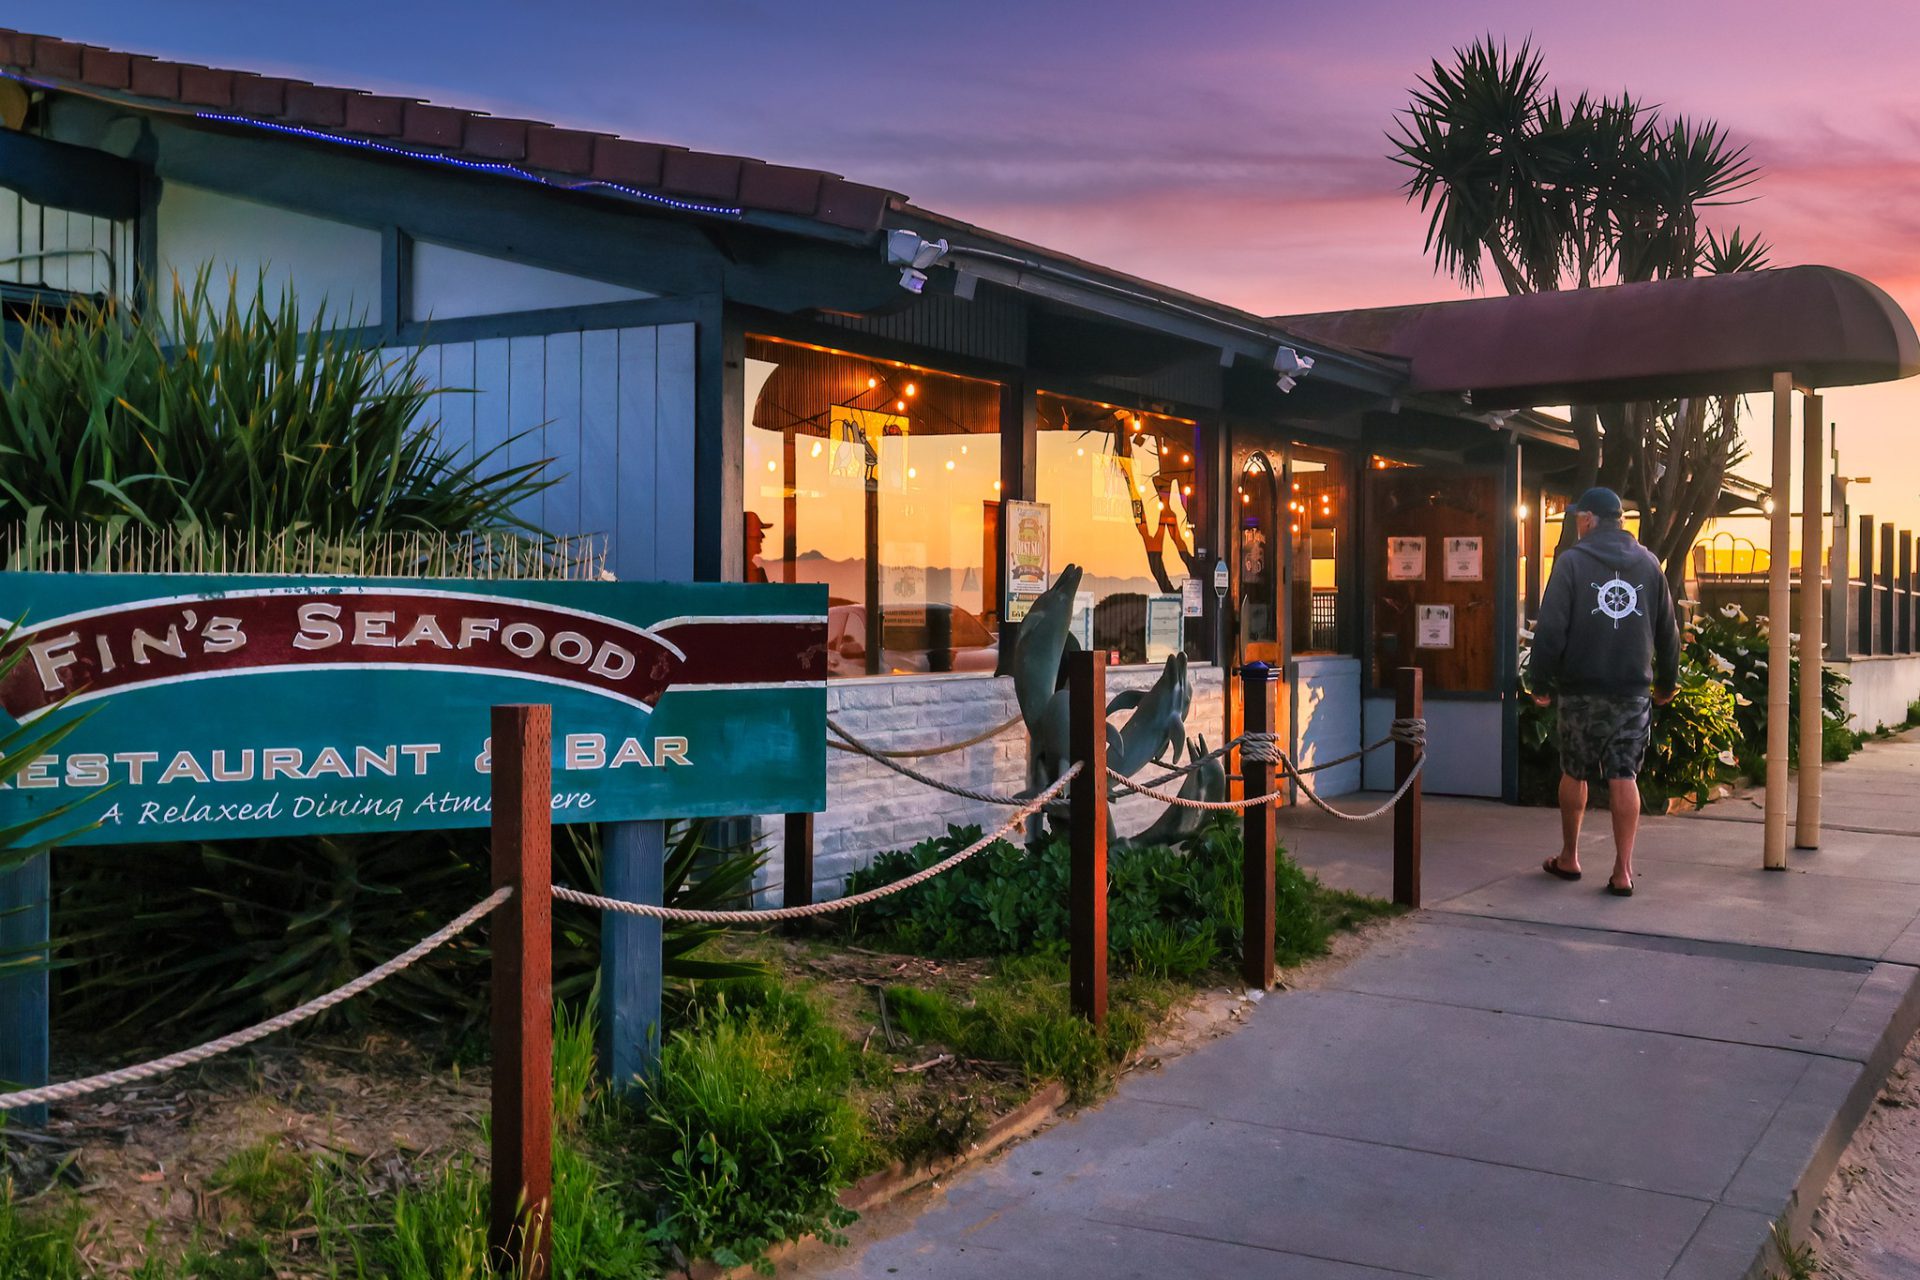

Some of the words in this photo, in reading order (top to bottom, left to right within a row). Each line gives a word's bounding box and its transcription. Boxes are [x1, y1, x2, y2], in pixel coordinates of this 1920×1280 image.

[293, 603, 636, 680] SEAFOOD
[0, 743, 441, 789] ESTAURANT
[564, 733, 694, 769] BAR
[98, 803, 123, 825] A
[138, 793, 283, 825] Relaxed
[292, 791, 403, 823] Dining
